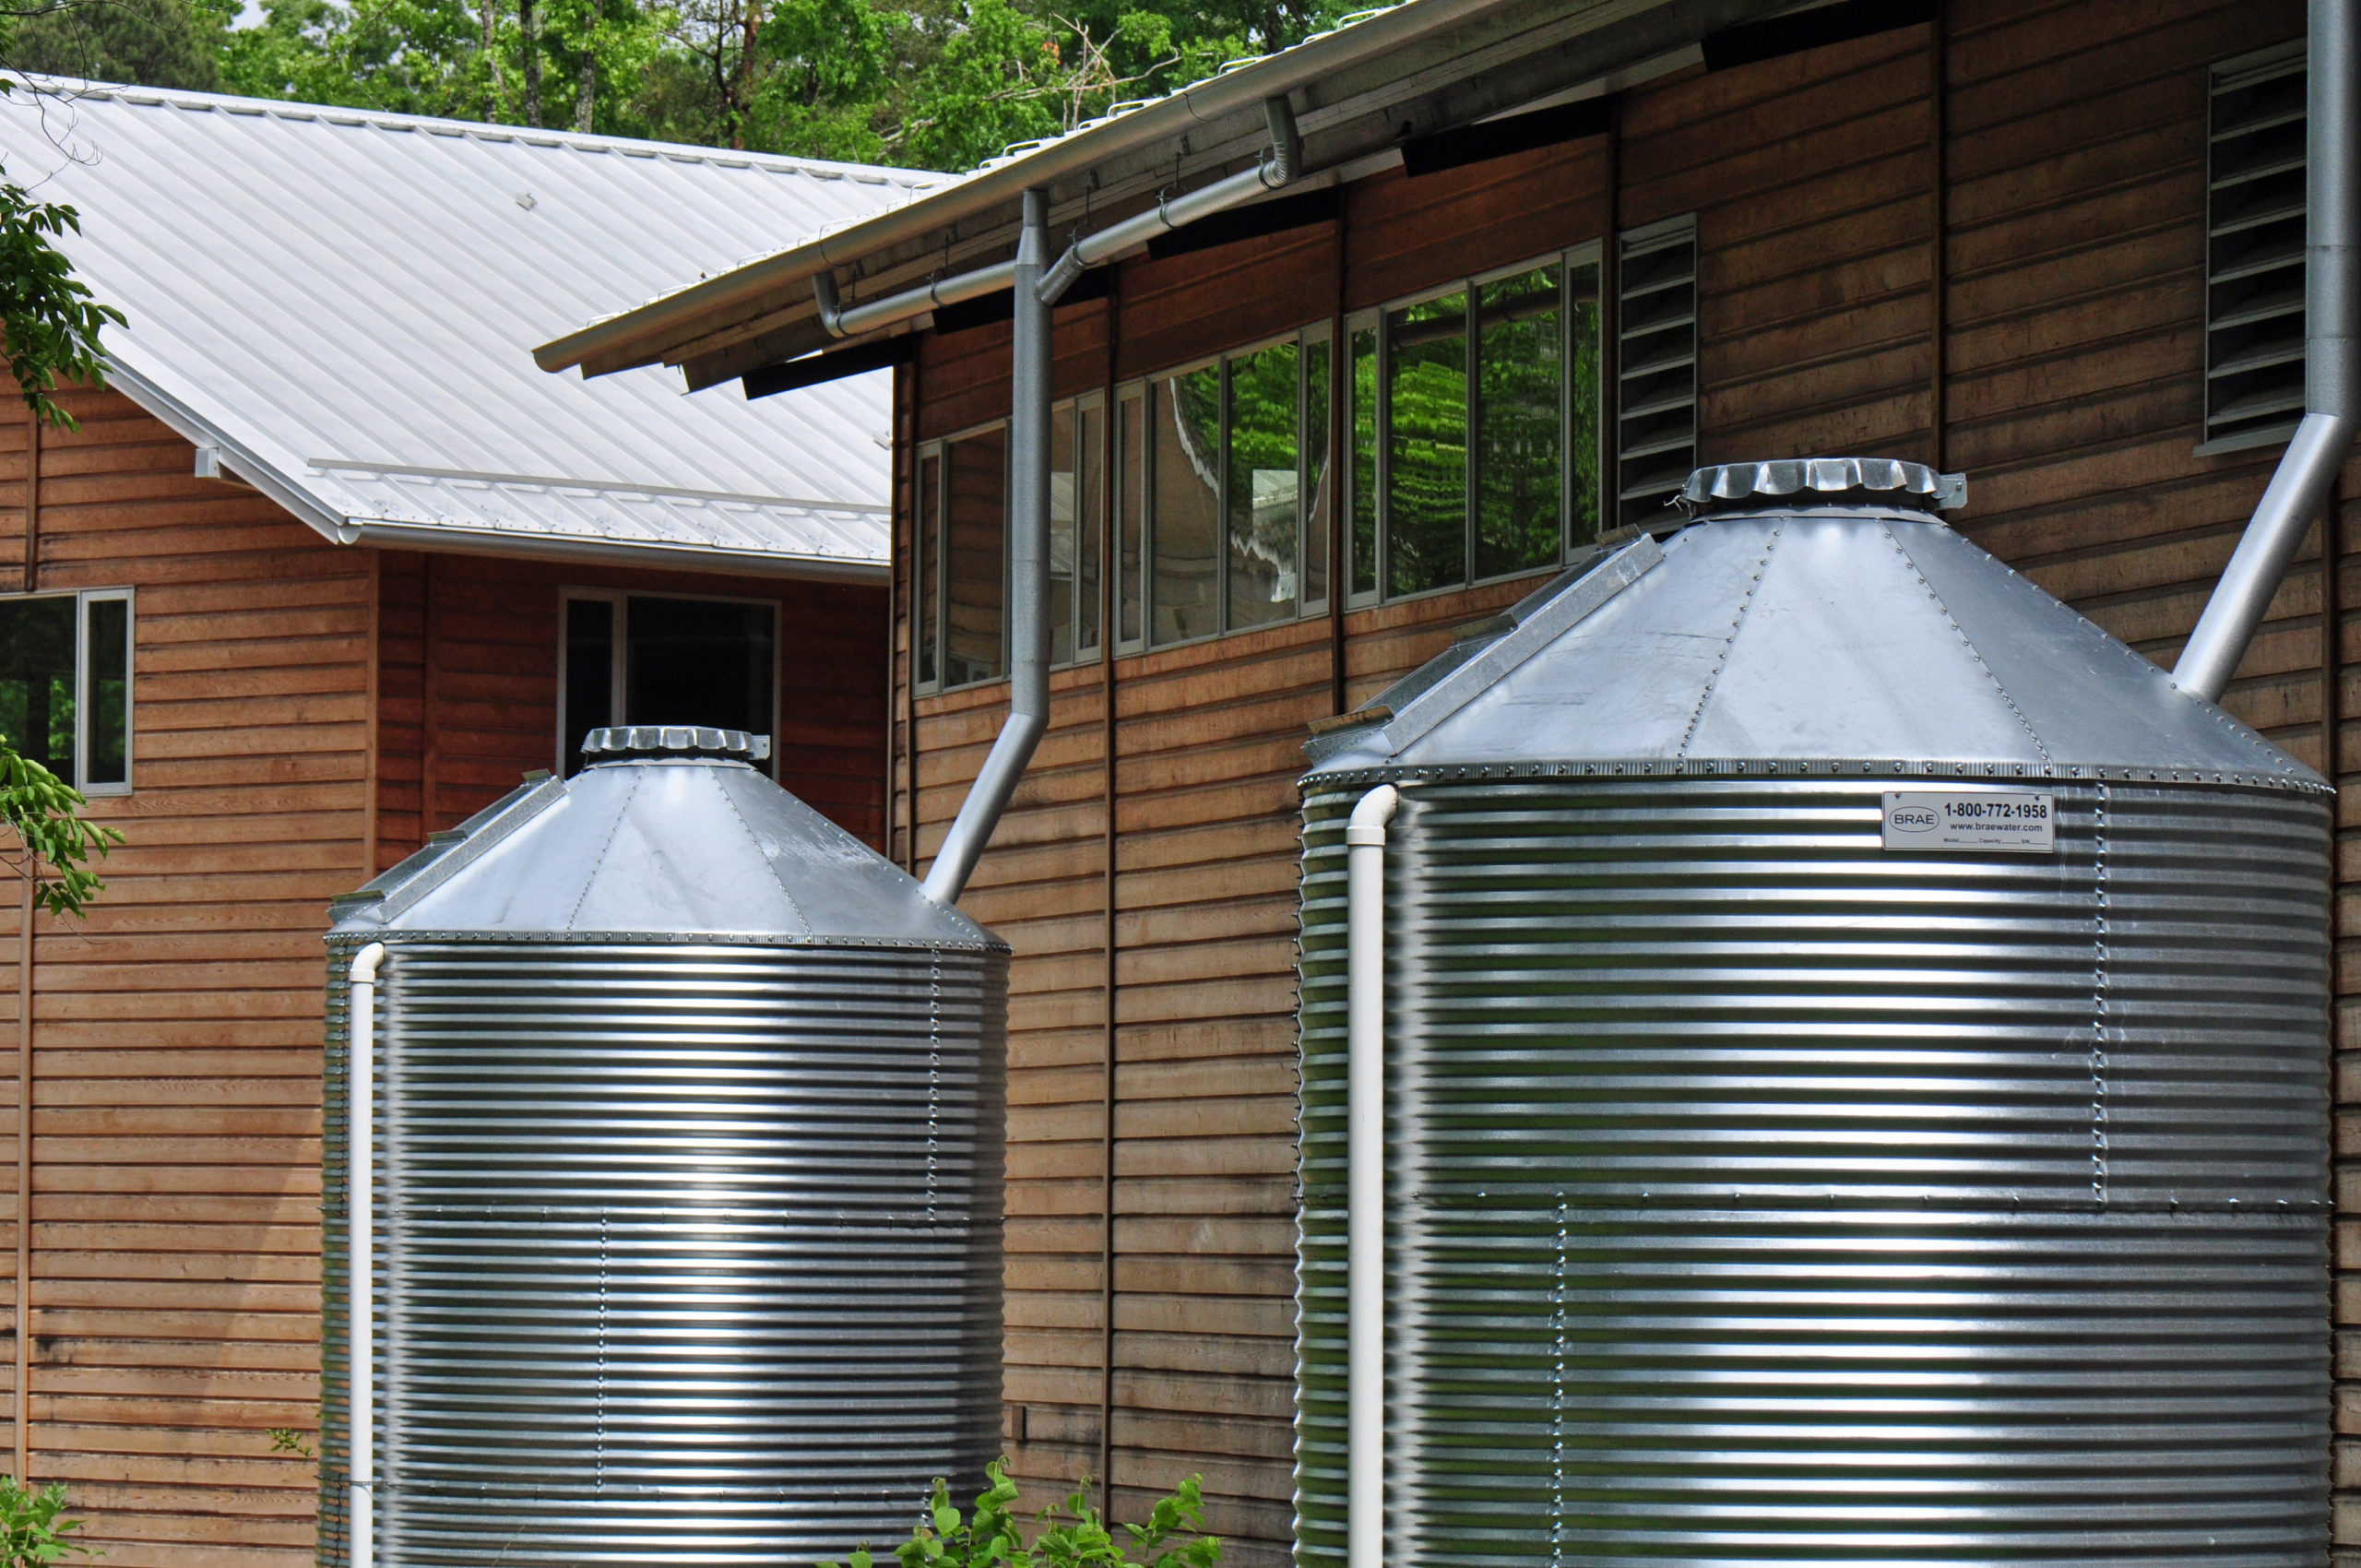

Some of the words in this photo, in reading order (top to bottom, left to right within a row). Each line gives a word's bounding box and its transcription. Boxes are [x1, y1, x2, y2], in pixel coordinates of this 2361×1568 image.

[1944, 802, 2047, 819] 1-800-772-1958
[1894, 814, 1935, 825] BRAE
[1950, 822, 2043, 832] www.braewater.com
